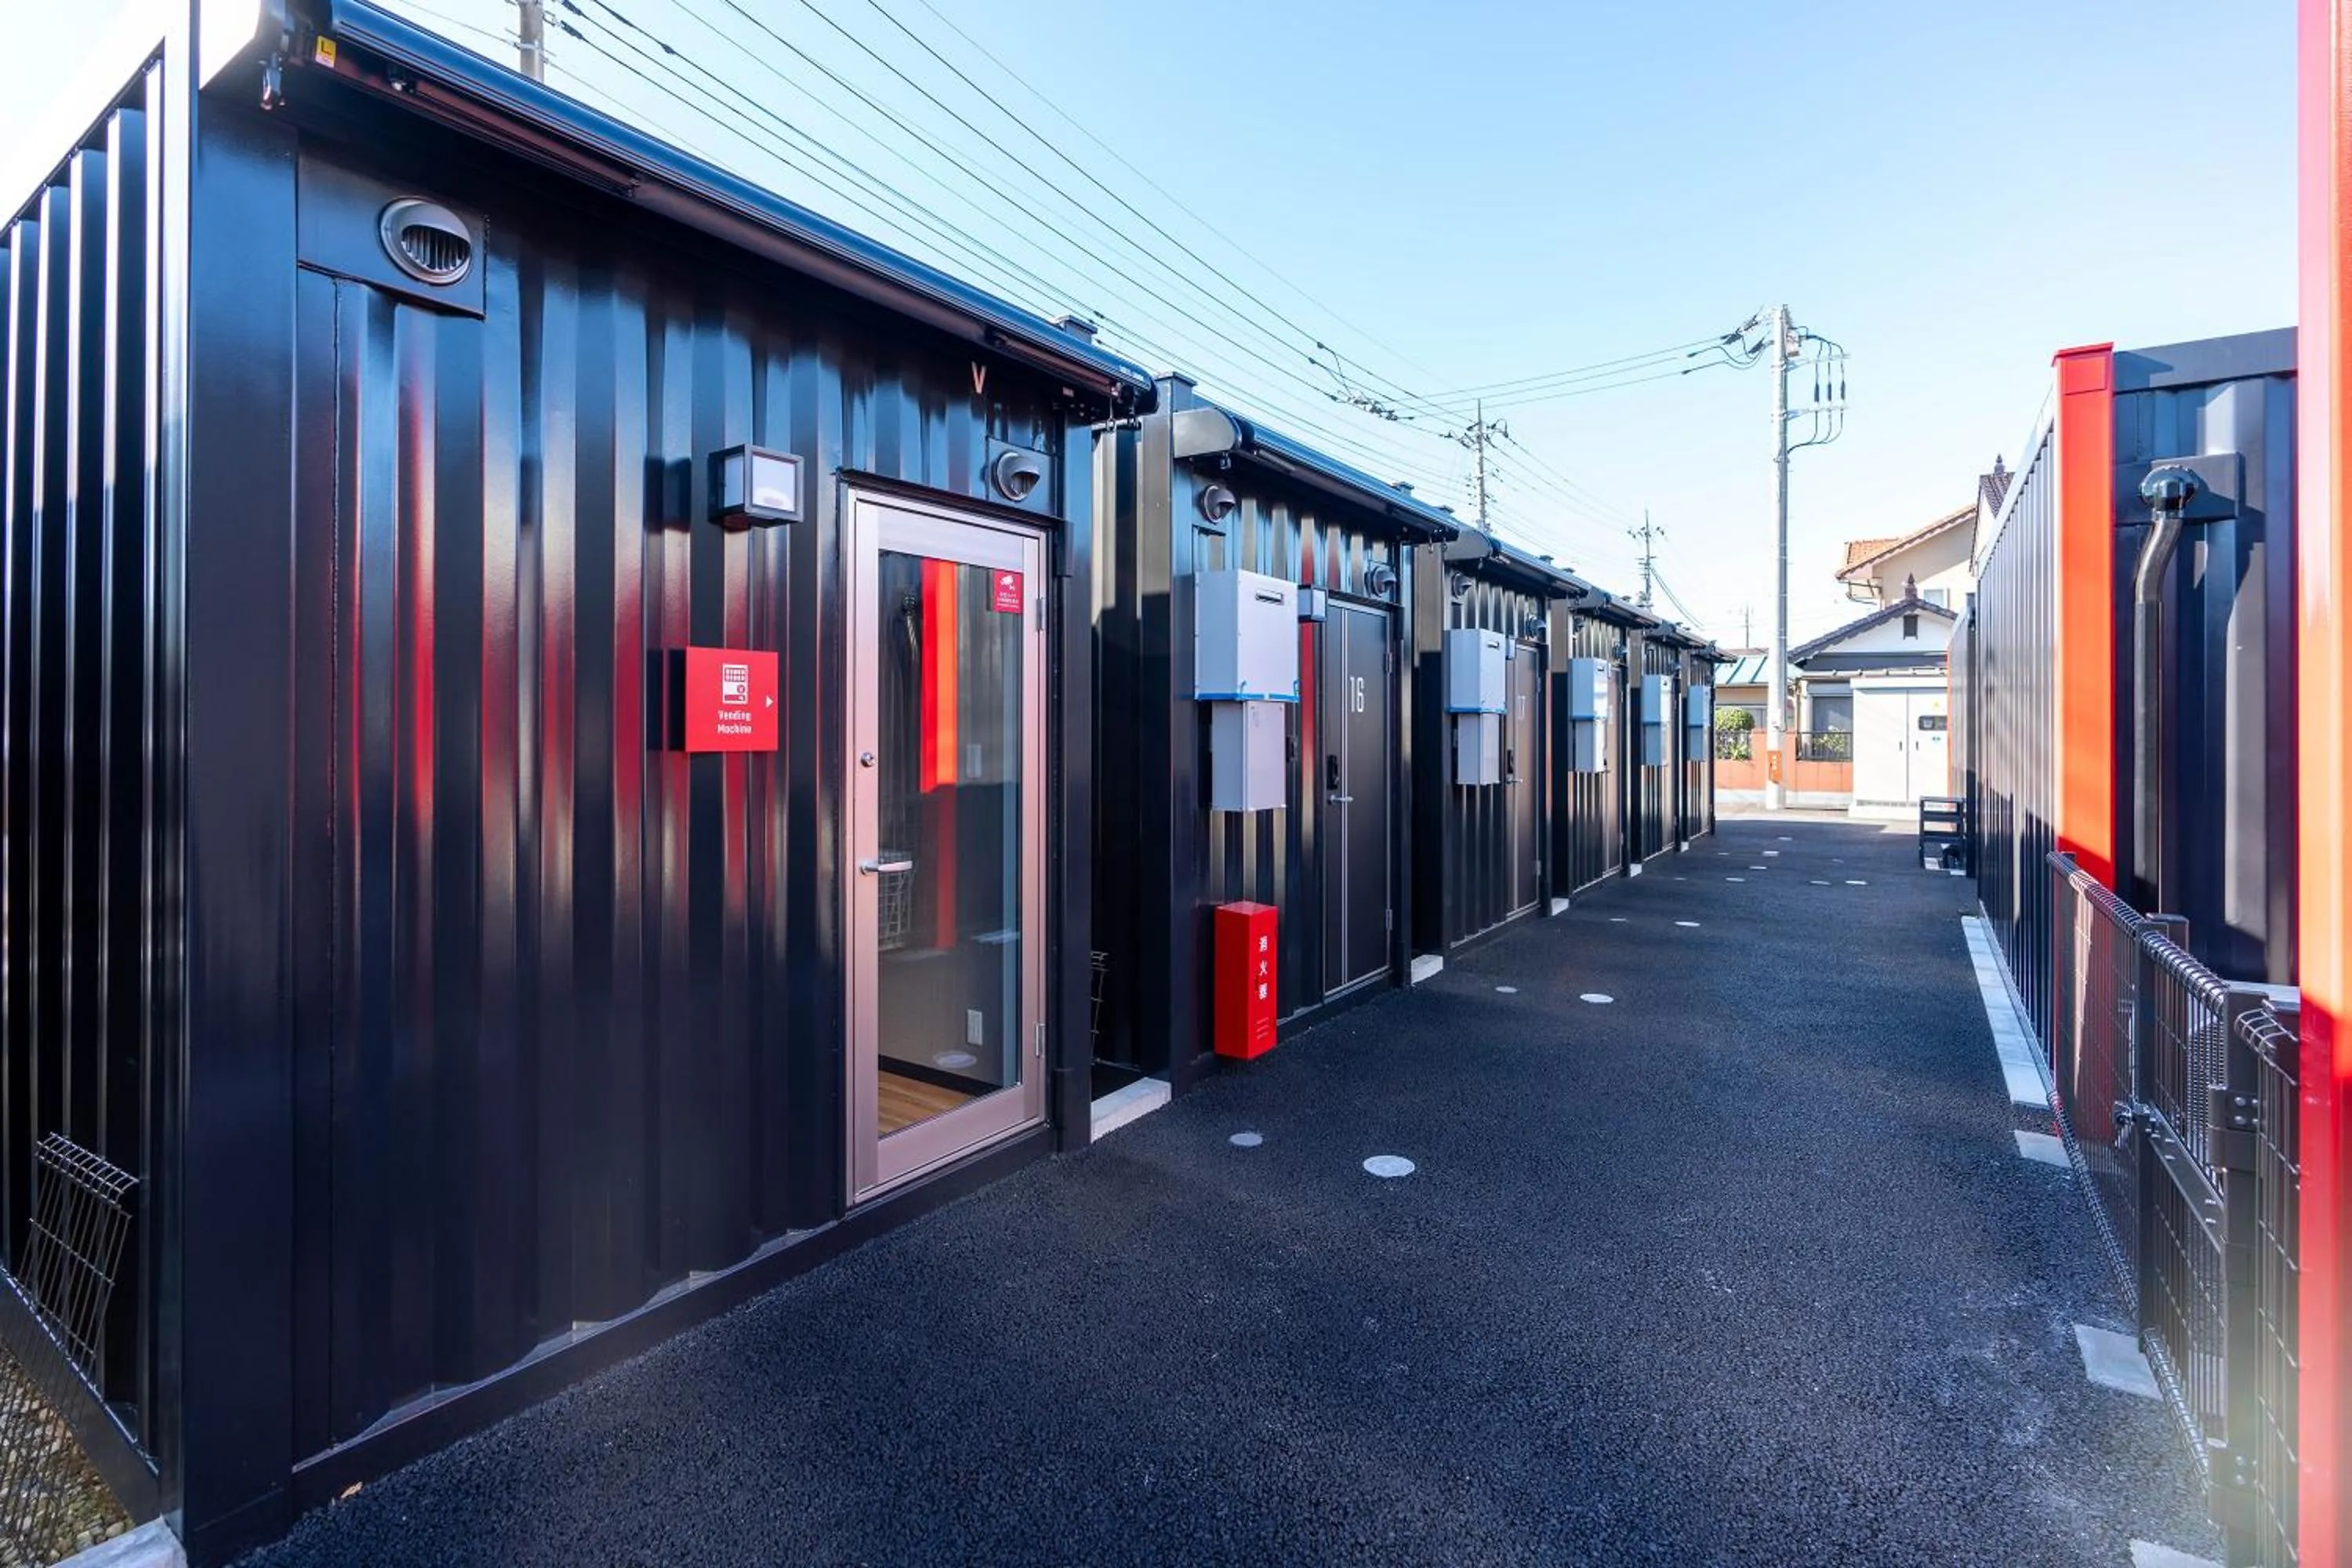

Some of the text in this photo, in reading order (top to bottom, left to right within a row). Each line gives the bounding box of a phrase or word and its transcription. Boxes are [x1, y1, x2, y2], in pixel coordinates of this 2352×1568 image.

[971, 361, 987, 394] V
[1349, 677, 1365, 713] 16
[717, 710, 752, 722] Vending
[717, 723, 753, 735] Machine
